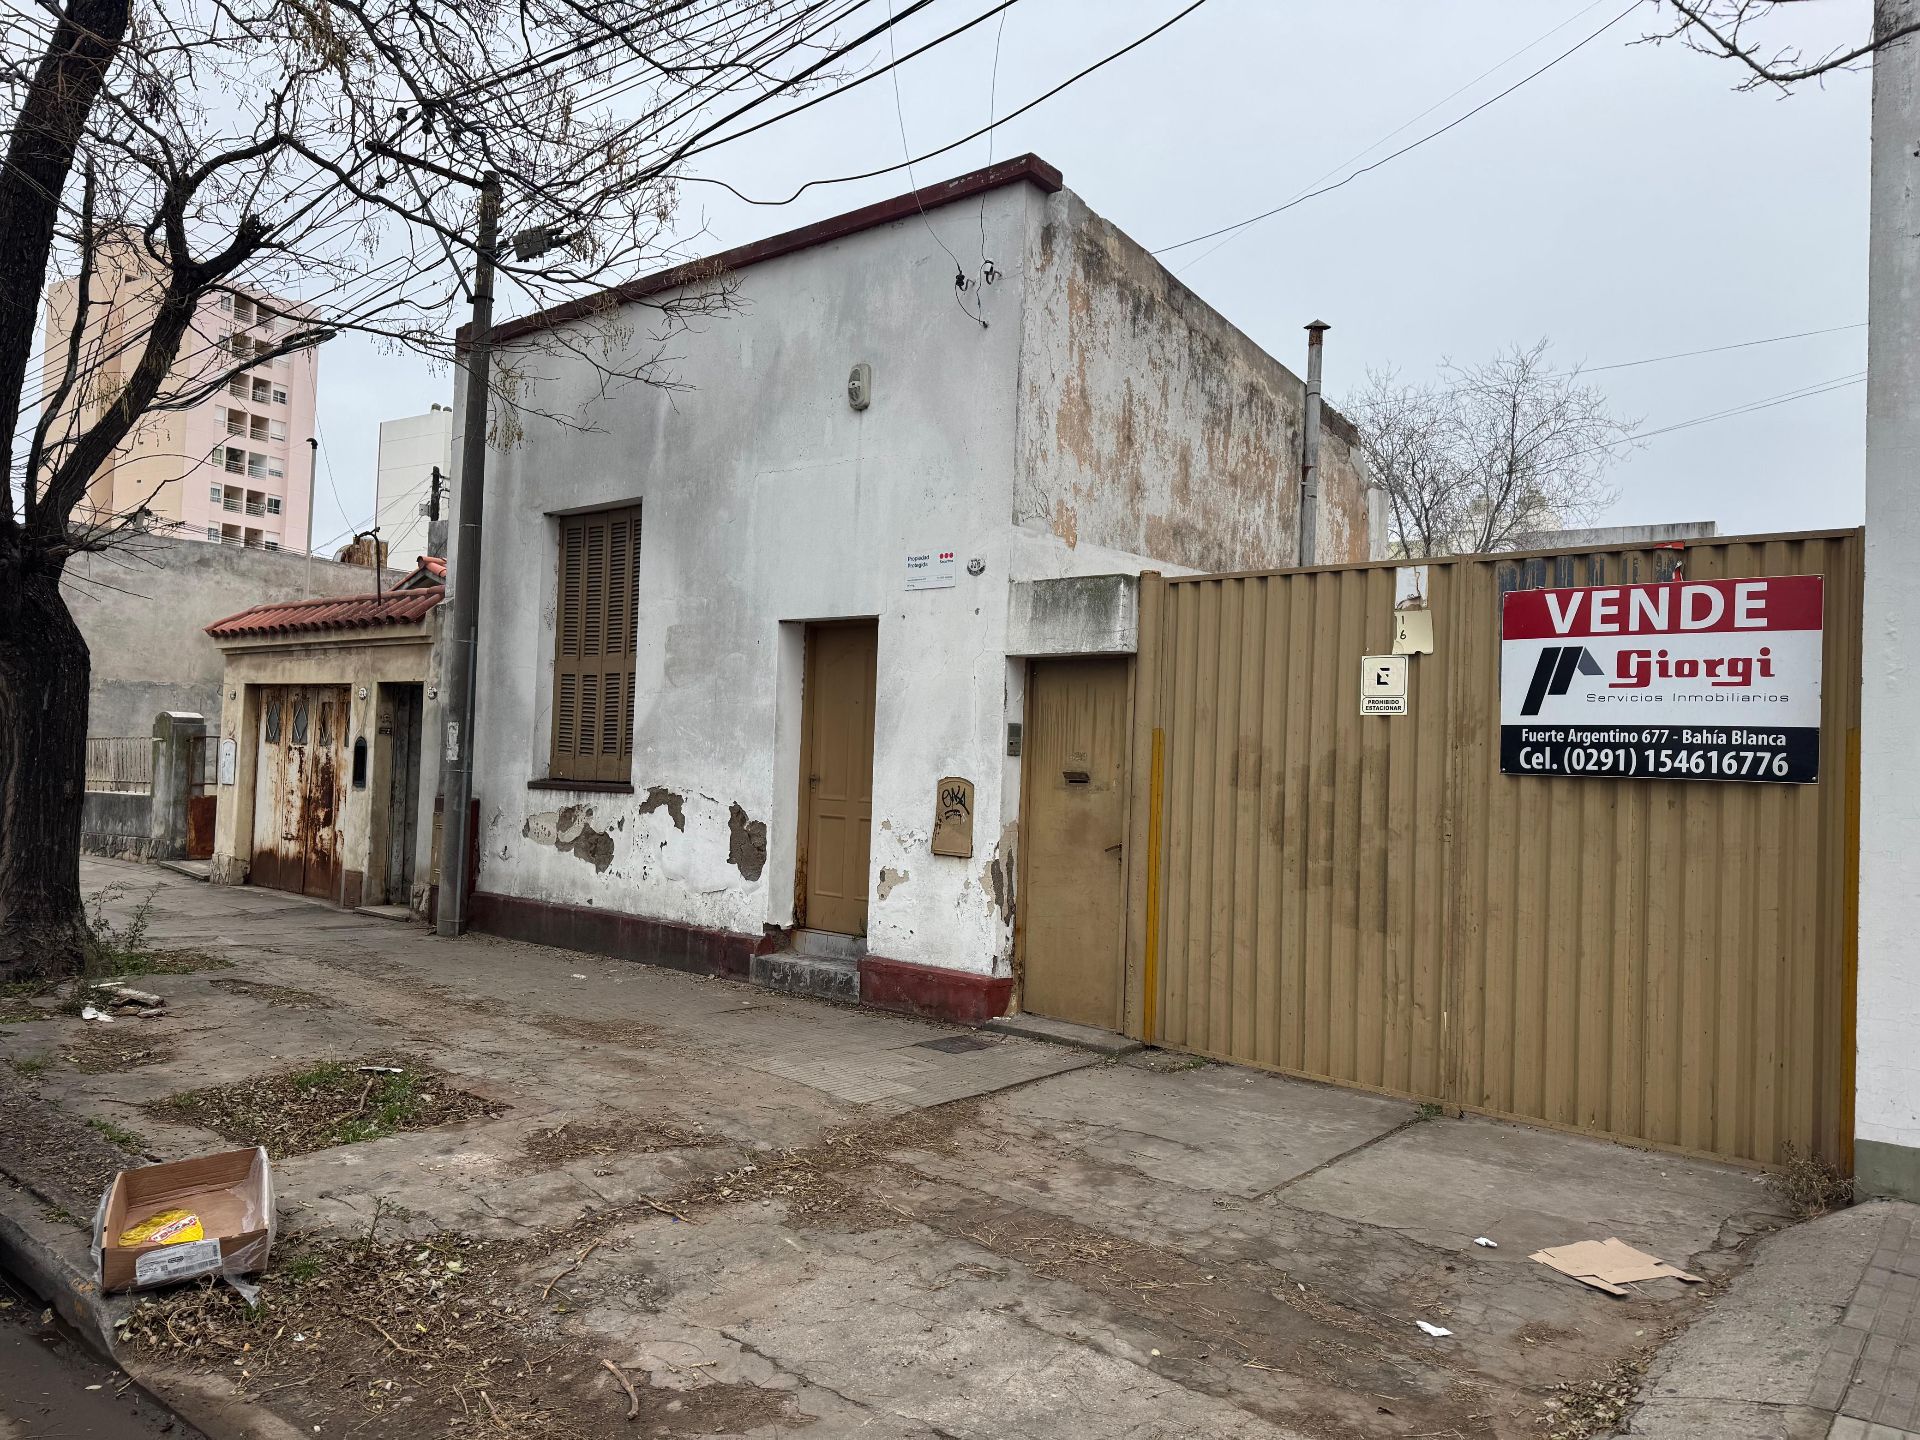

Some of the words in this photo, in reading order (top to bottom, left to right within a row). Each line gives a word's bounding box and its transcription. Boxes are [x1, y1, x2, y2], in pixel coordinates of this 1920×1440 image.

[1545, 581, 1768, 634] VENDE
[1400, 629, 1407, 640] 6
[1608, 646, 1775, 688] Giorgi
[1586, 693, 1663, 702] Servicios
[1672, 692, 1790, 703] Inmobiliarios
[1521, 728, 1565, 743] Fuerte
[1567, 729, 1638, 746] Argentino
[1641, 729, 1669, 744] 677
[1682, 729, 1727, 745] Bahía
[1731, 730, 1786, 746] Blanca
[1519, 746, 1557, 770] Cel.
[1563, 747, 1636, 775] (0291)
[1644, 749, 1789, 777] 154616776
